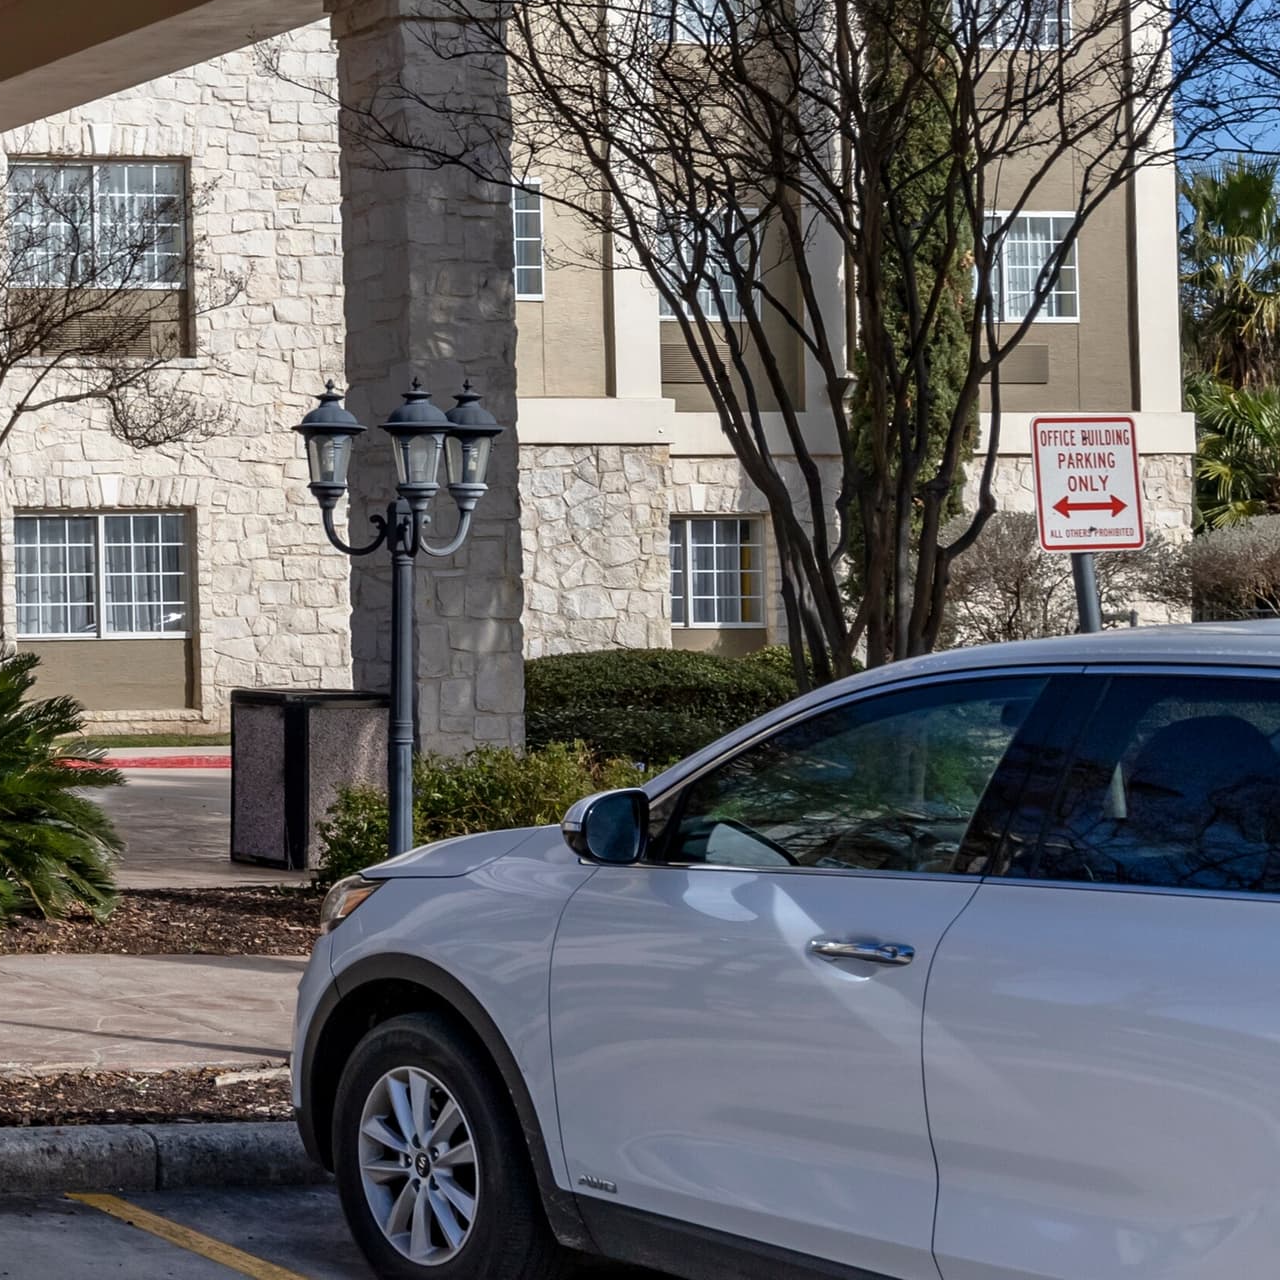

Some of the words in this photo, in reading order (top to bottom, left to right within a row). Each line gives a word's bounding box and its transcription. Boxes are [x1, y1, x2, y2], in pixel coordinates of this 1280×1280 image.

[1040, 430, 1076, 447] OFFICE
[1081, 429, 1130, 446] BUILDING
[1057, 452, 1116, 470] PARKING
[1067, 475, 1109, 492] ONLY
[1050, 529, 1063, 539] ALL
[1065, 528, 1092, 538] OTHERS
[1094, 527, 1135, 537] PROHIBITED
